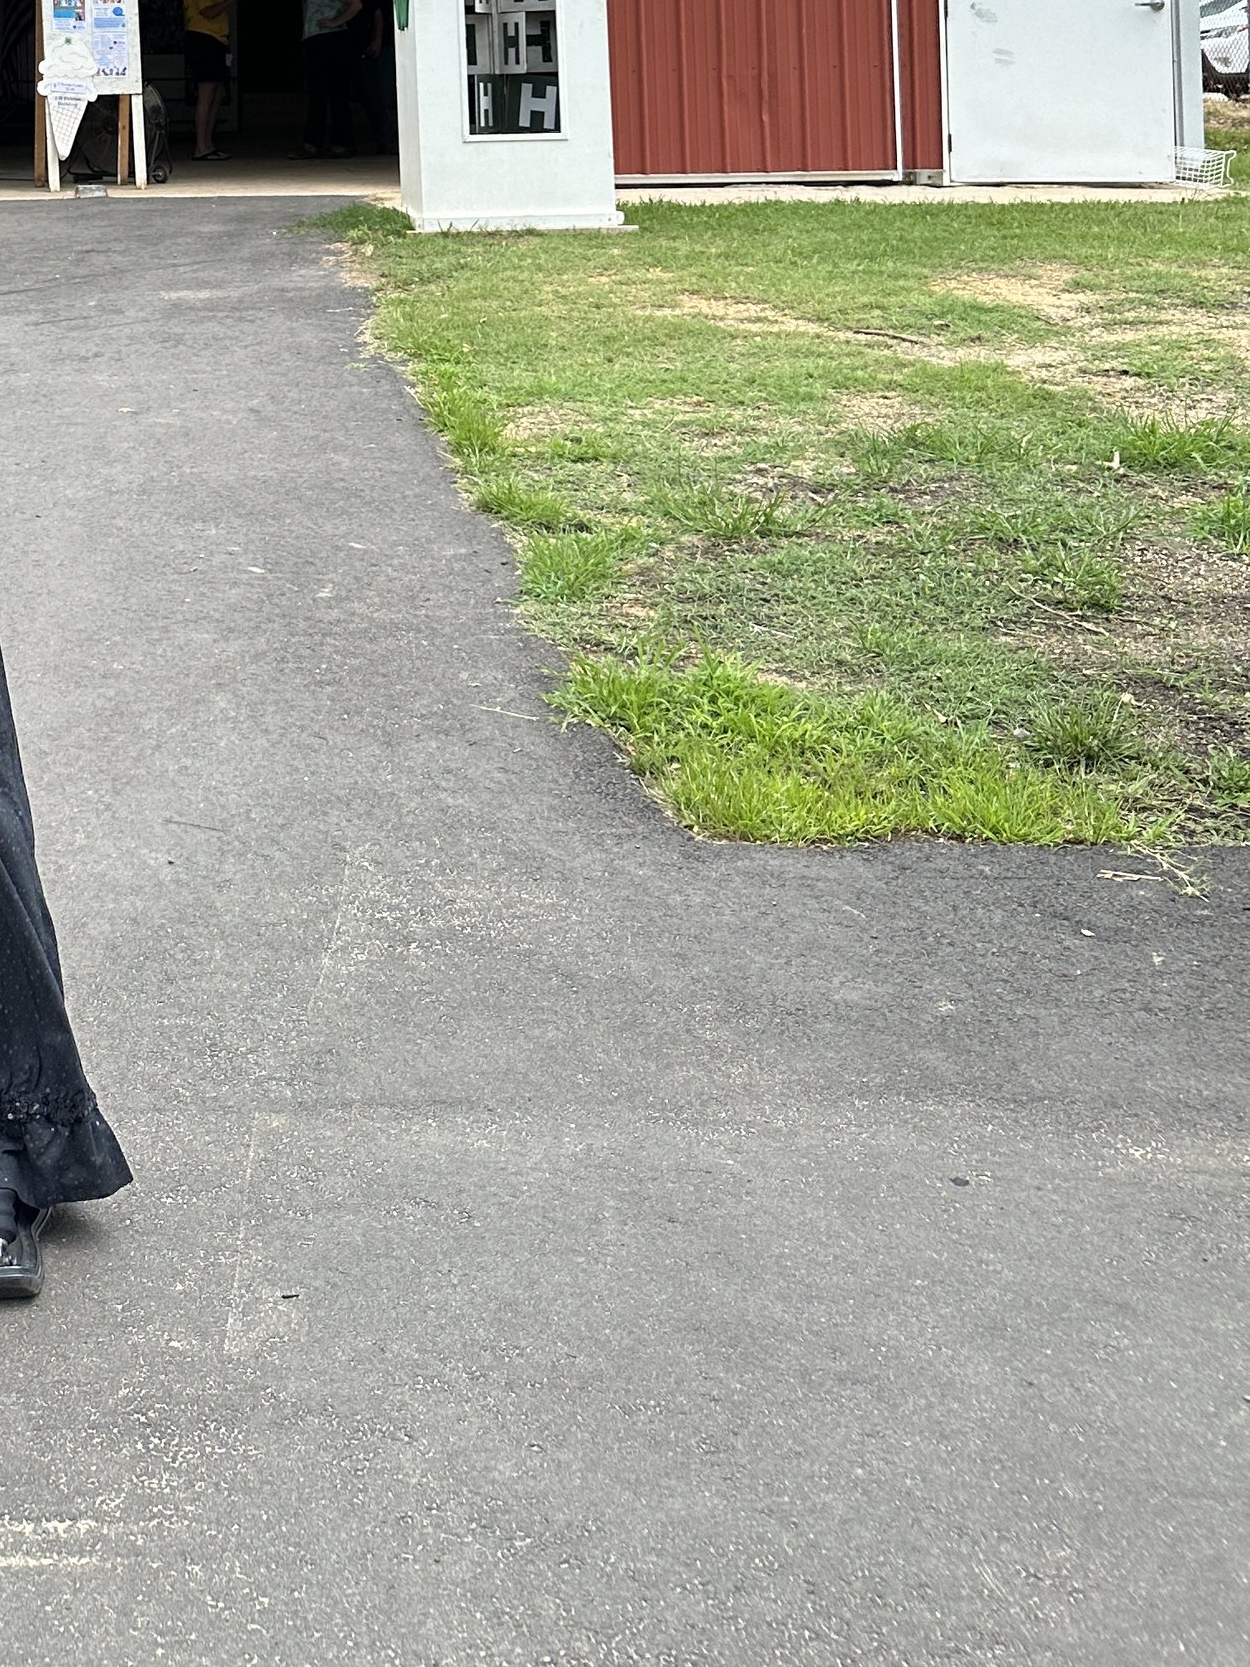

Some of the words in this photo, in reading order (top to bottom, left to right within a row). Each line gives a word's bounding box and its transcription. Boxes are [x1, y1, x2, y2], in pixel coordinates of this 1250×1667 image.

[503, 22, 520, 65] H
[479, 82, 493, 127] H
[519, 82, 558, 130] H
